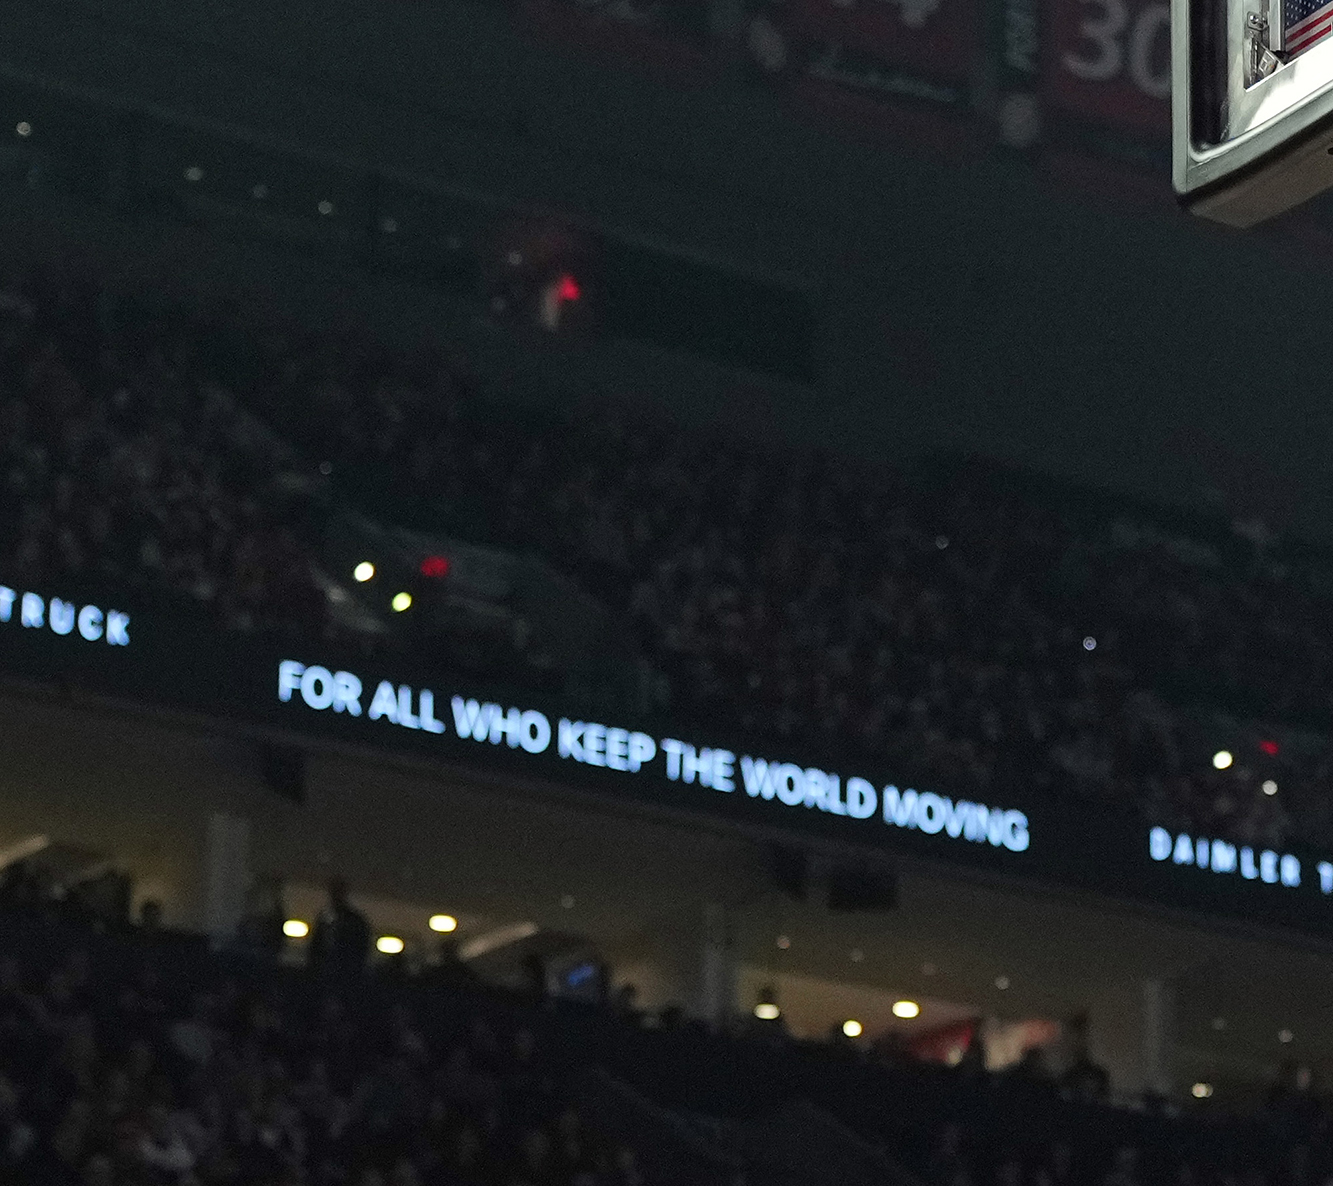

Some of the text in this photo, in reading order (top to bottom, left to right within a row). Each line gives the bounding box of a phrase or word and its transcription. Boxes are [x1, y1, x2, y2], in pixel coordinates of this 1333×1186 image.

[278, 659, 1030, 852] FOR ALL WHO KEEP THE WORLD MOVING
[1149, 826, 1300, 888] DAIMLER
